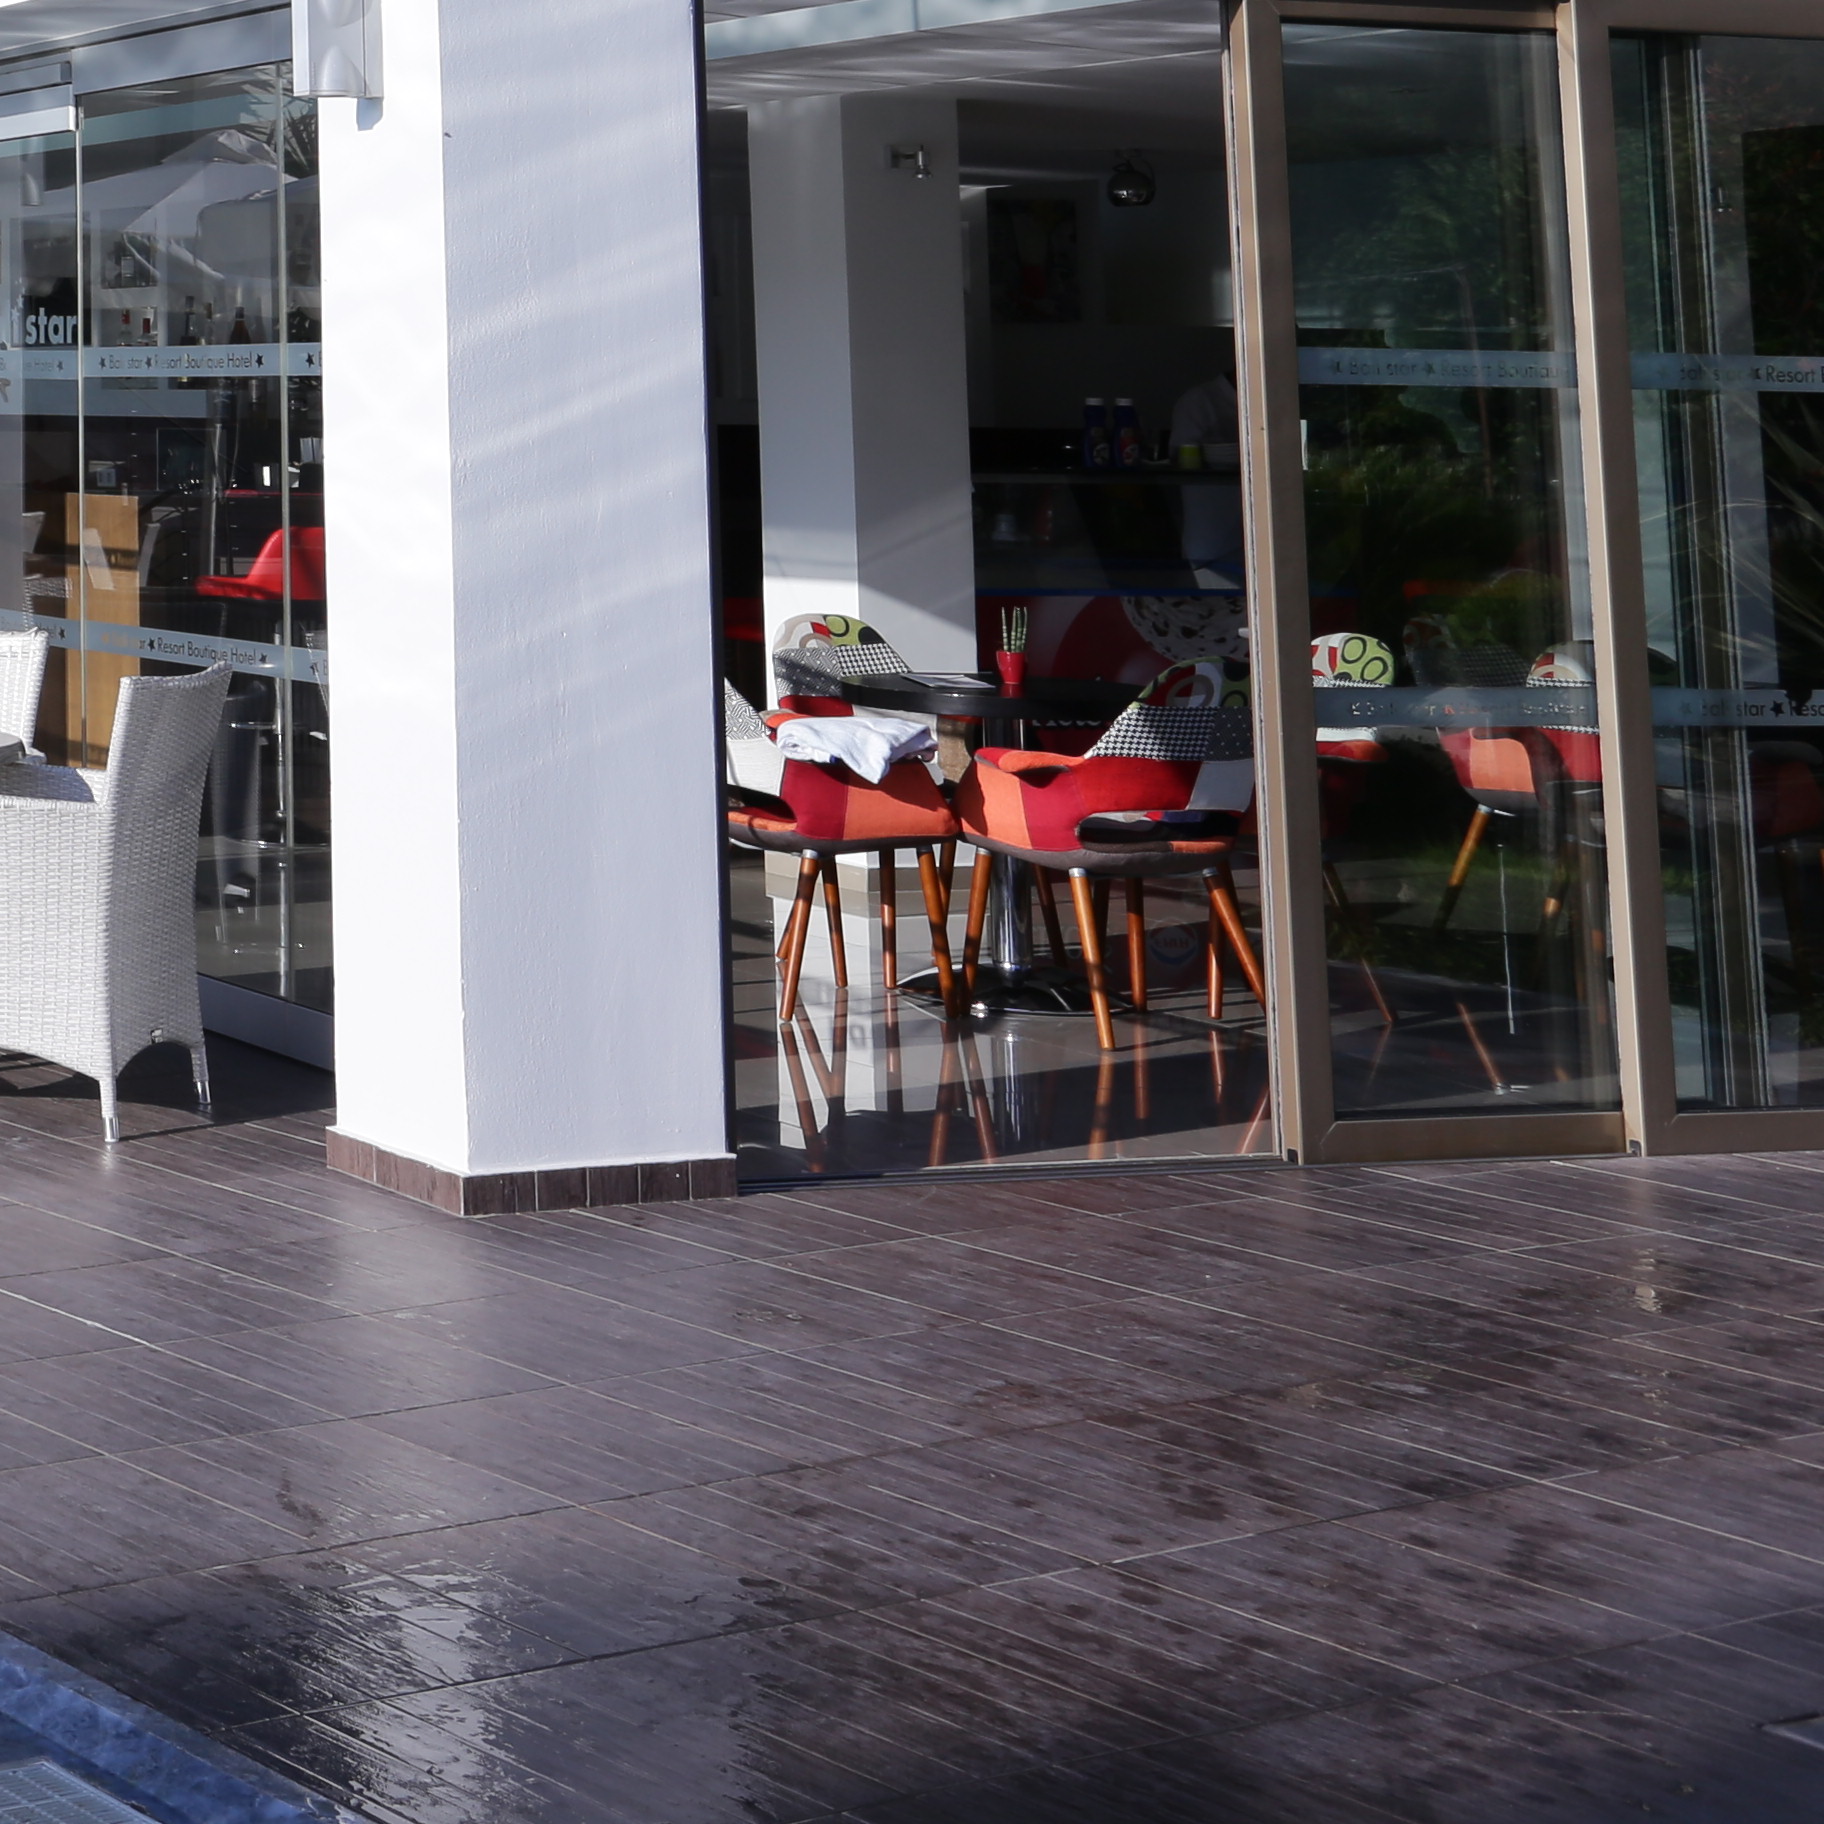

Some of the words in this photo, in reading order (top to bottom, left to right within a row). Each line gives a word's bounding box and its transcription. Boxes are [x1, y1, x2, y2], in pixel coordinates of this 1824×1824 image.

[25, 307, 78, 345] star
[227, 351, 252, 368] Hotel
[1766, 365, 1815, 383] Resort
[157, 637, 185, 655] Resort
[188, 640, 228, 662] Boutique
[231, 647, 256, 665] Hotel
[1736, 701, 1766, 717] star
